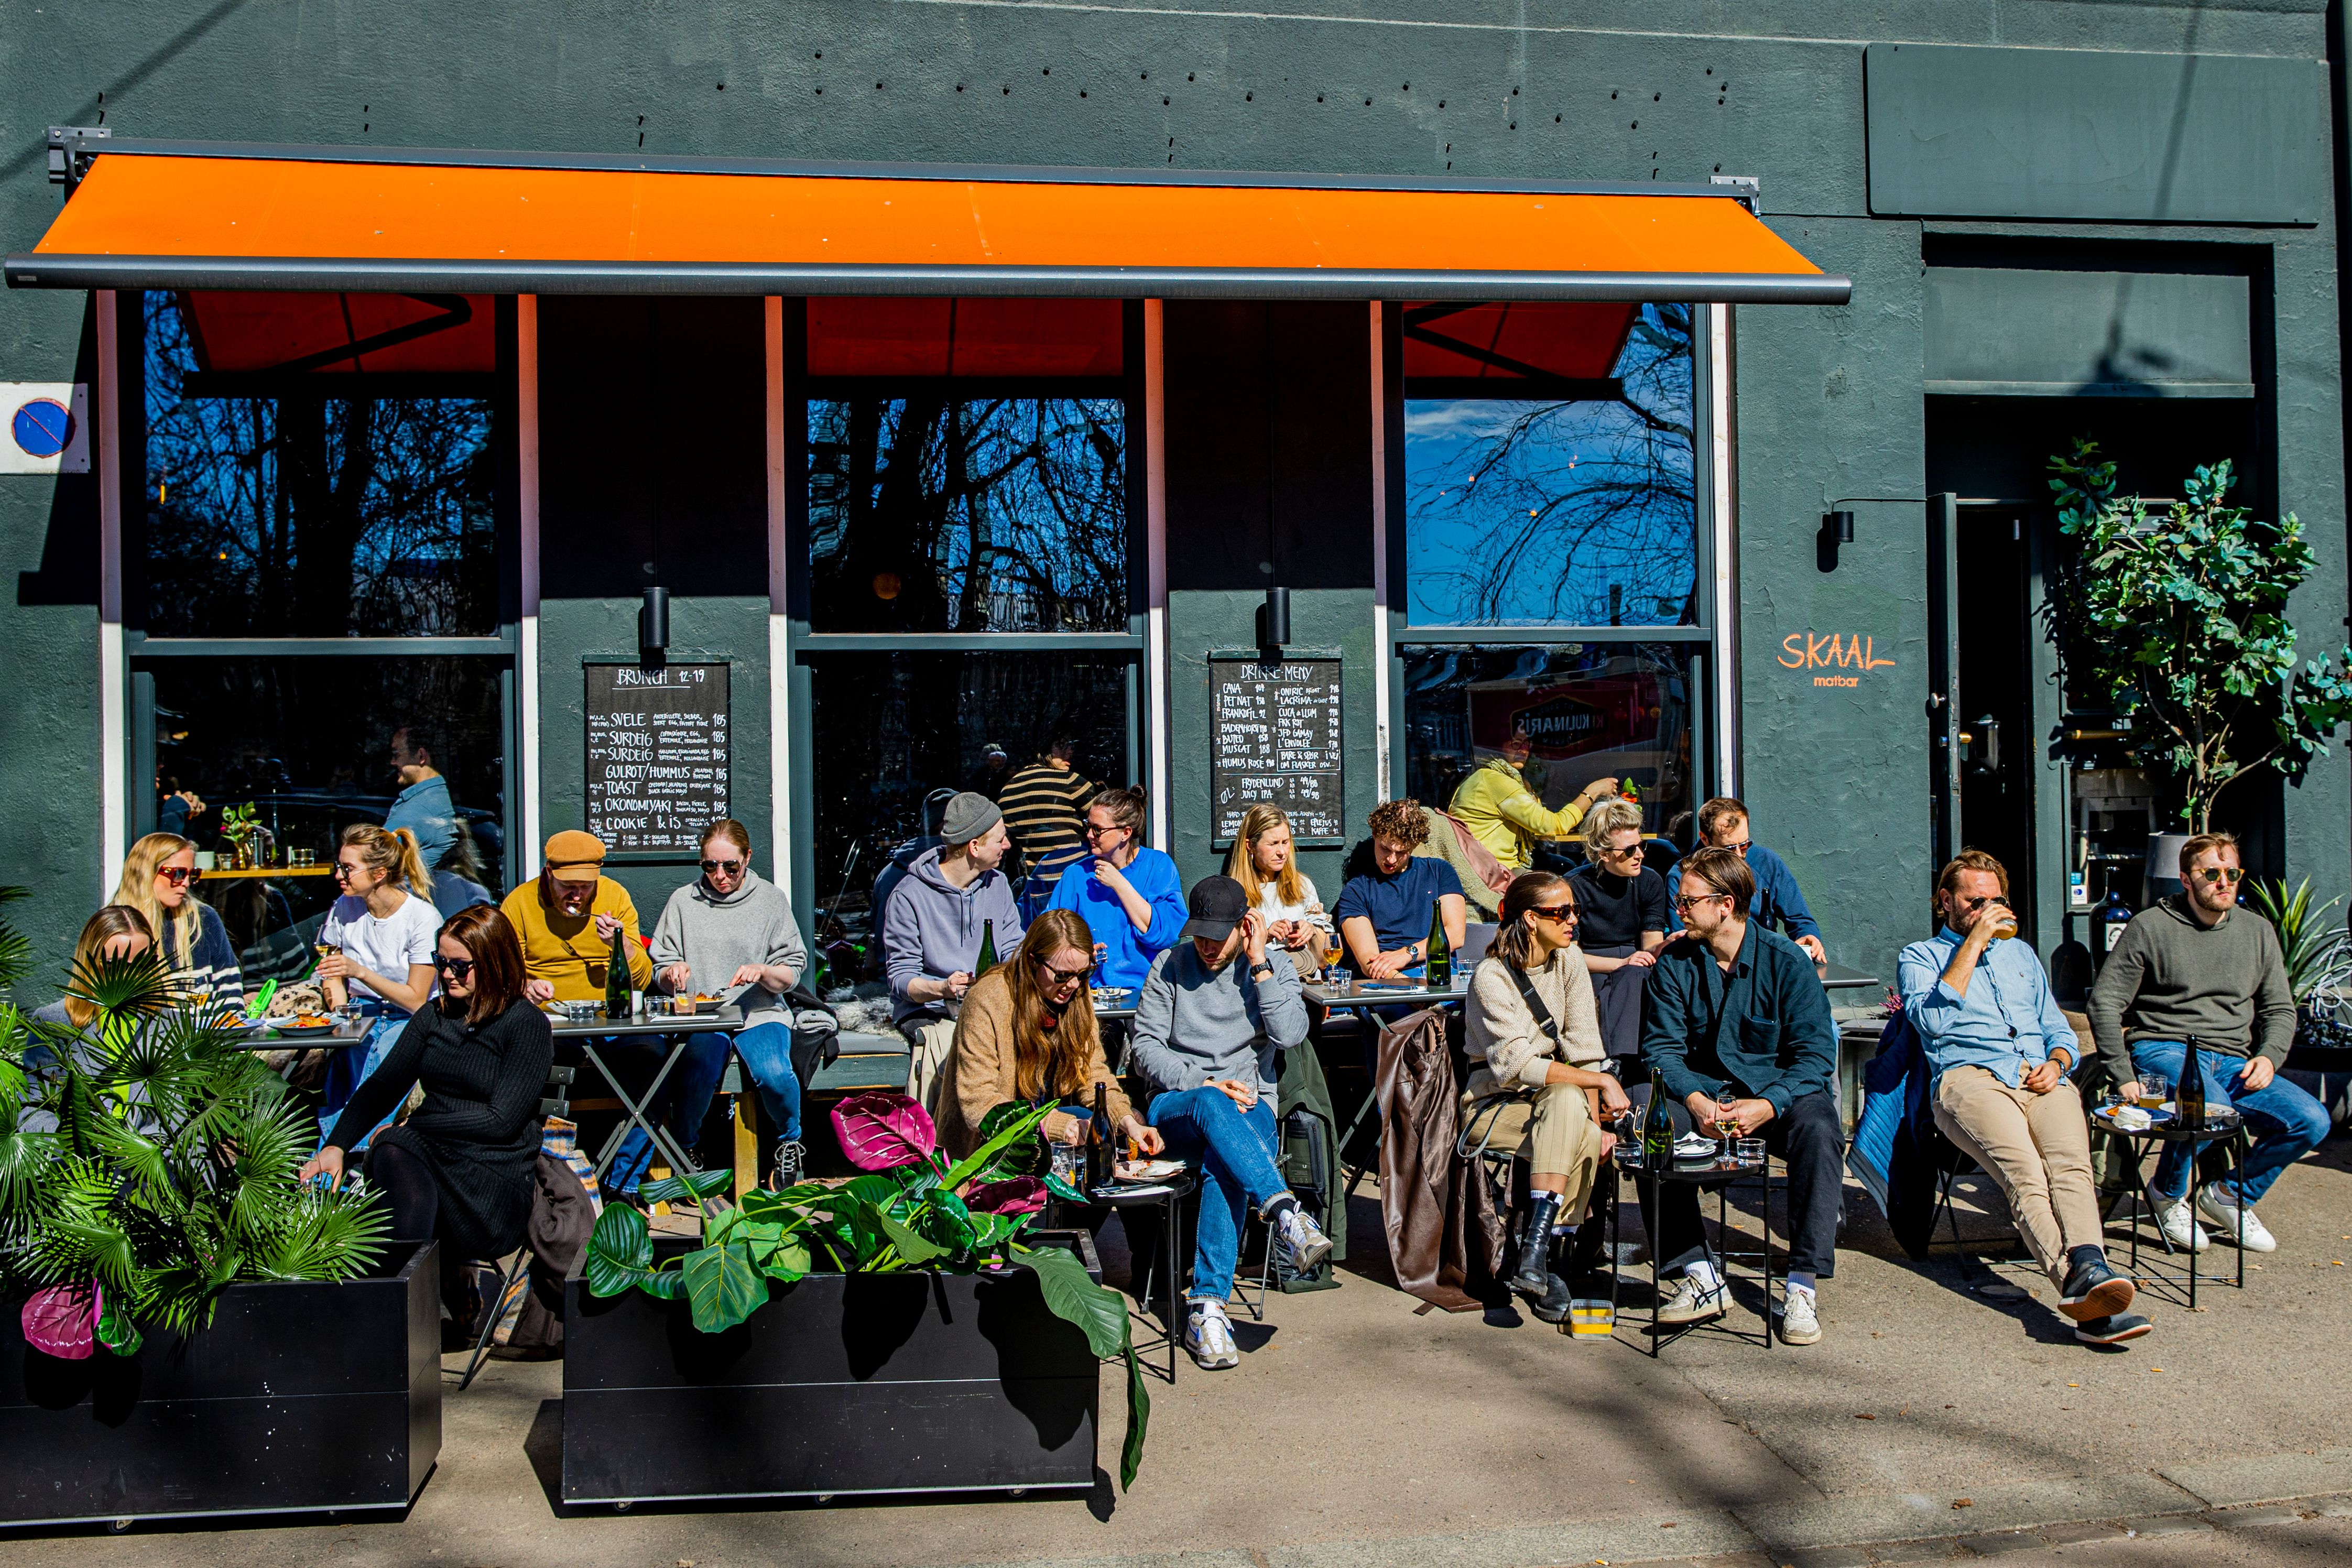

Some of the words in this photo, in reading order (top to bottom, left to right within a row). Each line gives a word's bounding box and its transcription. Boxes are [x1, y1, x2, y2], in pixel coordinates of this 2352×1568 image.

[1778, 633, 1896, 670] SKAAL
[616, 669, 668, 685] BRUNCH
[679, 669, 704, 682] 12-19
[1813, 675, 1859, 688] matbar
[1223, 683, 1242, 694] CAVA
[1224, 695, 1237, 707] PET
[1237, 695, 1254, 707] NAT
[1258, 709, 1267, 718] 92
[1278, 707, 1296, 718] CUCA
[611, 713, 647, 727] SVELE
[713, 713, 726, 727] 185
[712, 731, 725, 743] 185
[1292, 729, 1313, 740] GAMAY
[712, 748, 726, 761] 185
[1222, 744, 1252, 754] MUSCAT
[1259, 744, 1270, 755] 188
[1280, 750, 1296, 760] BARE
[1222, 758, 1246, 769] HUMUS
[1248, 756, 1264, 769] ROSÉ
[1291, 761, 1316, 769] FLASKER
[715, 768, 727, 780] 185
[604, 780, 642, 796] TOAST
[713, 783, 726, 796] 185
[1242, 777, 1284, 790] FRYDENLUND
[1300, 776, 1318, 788] 44/88
[1300, 788, 1320, 800] 49/98
[605, 798, 671, 815] OKONOMIYAKI
[713, 801, 726, 814] 185
[657, 815, 666, 829] &
[1310, 818, 1332, 827] EPLEJUS
[1311, 827, 1329, 835] KAFFE
